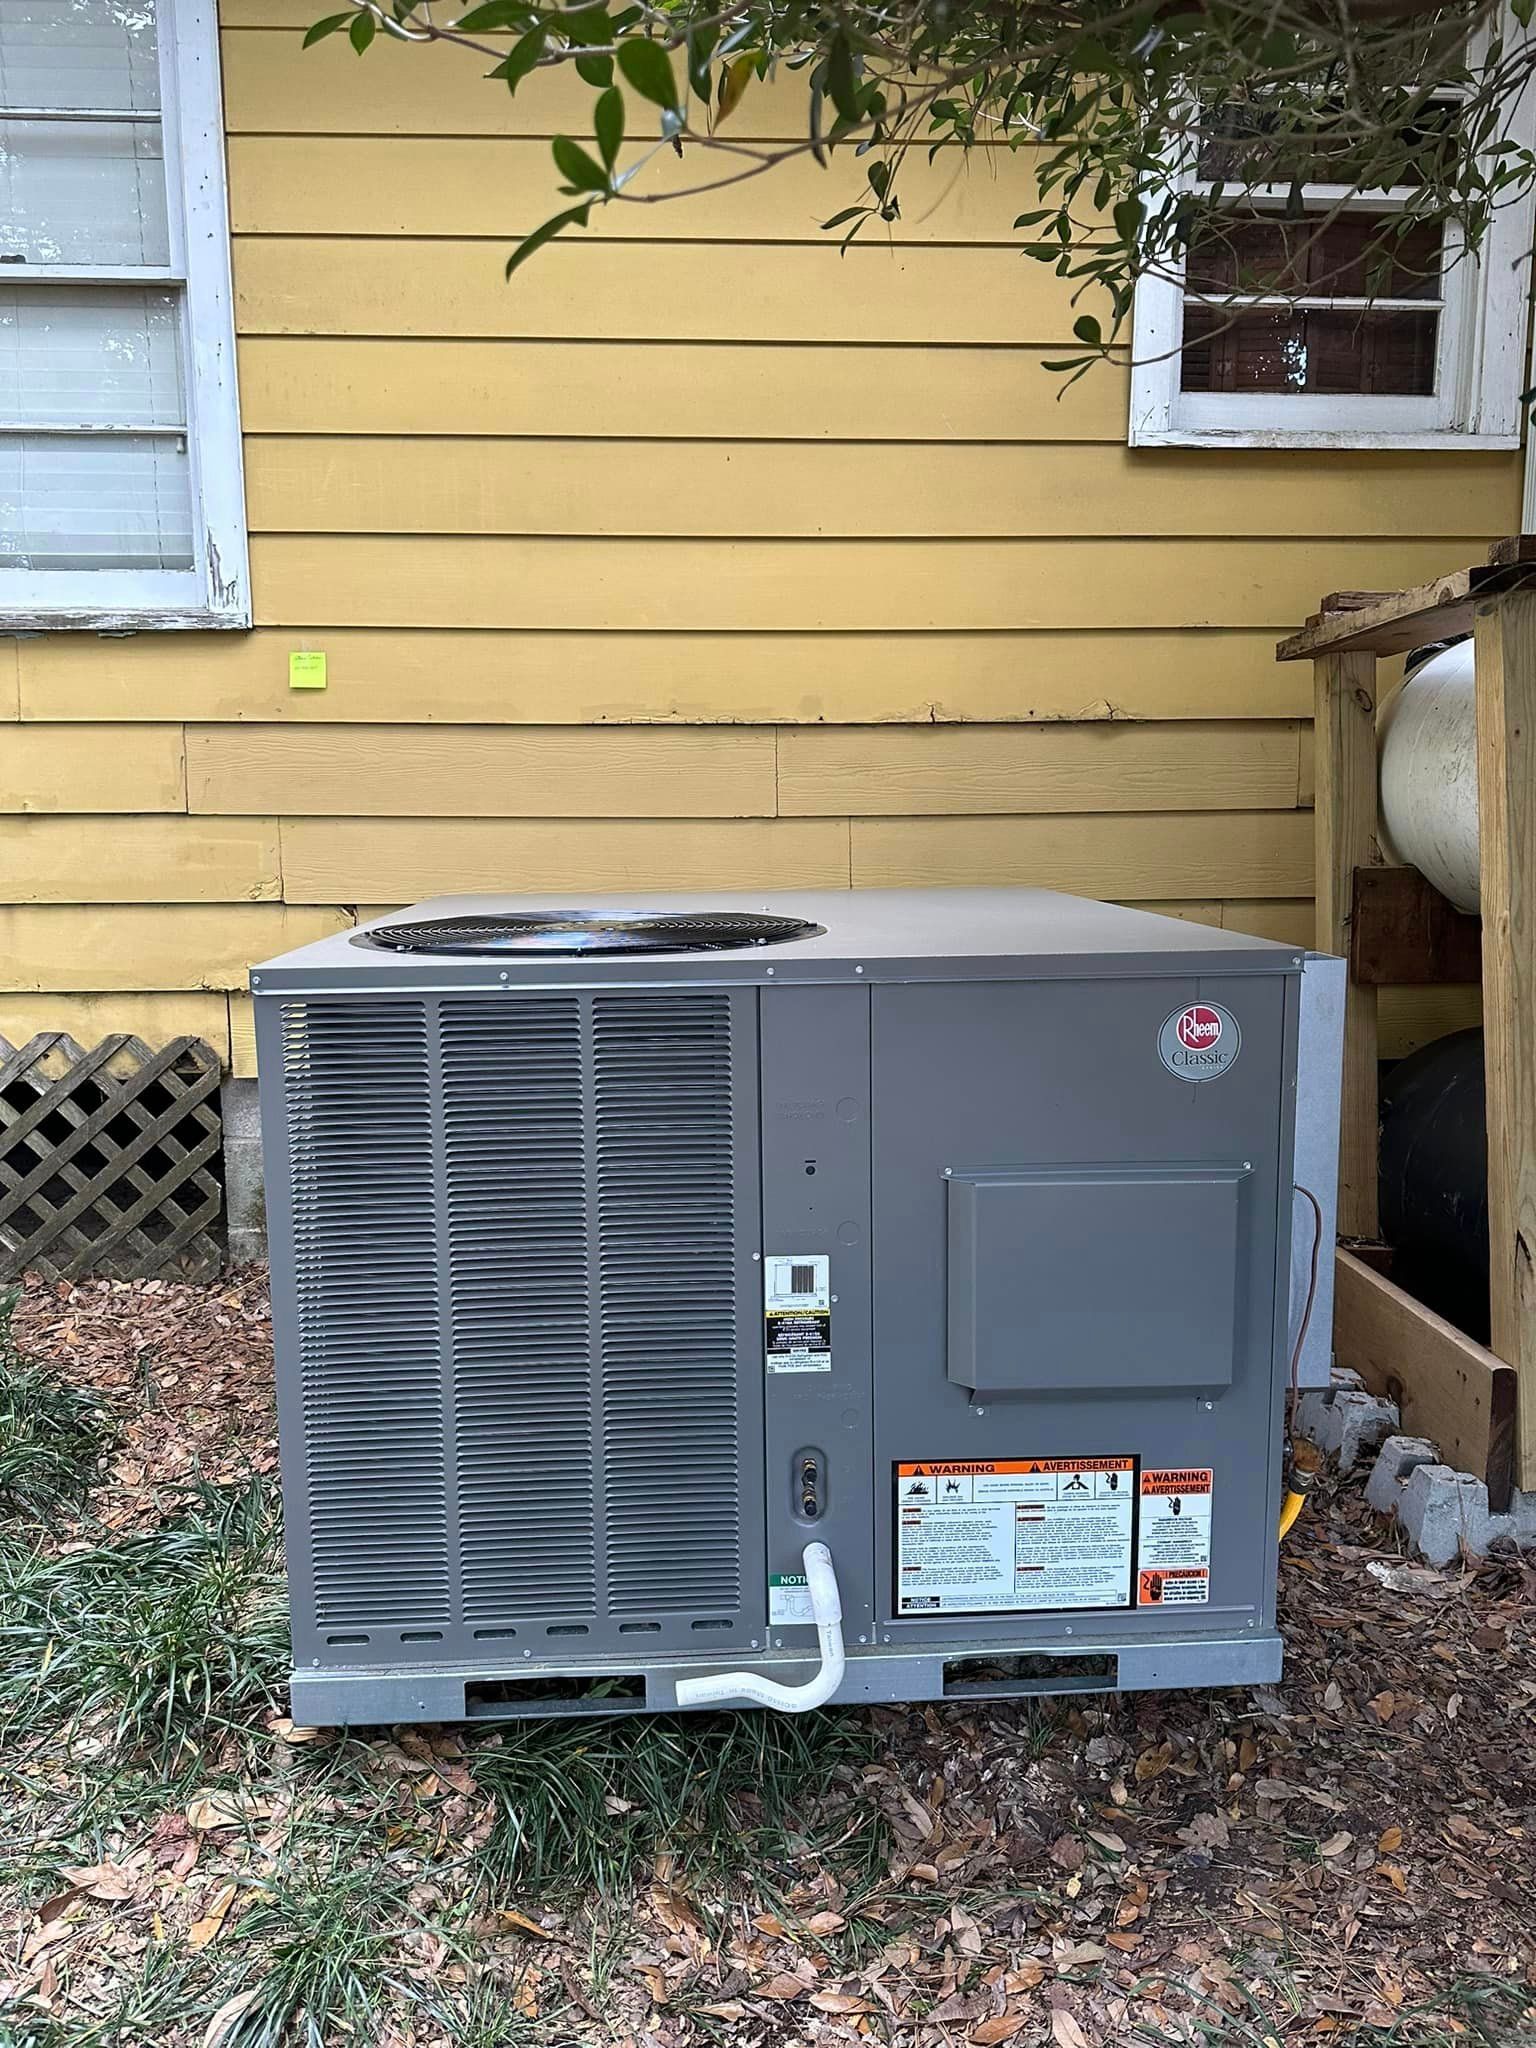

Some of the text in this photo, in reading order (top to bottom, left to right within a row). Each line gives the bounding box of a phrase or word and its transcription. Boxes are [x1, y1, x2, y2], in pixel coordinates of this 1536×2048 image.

[1183, 1008, 1219, 1042] Rheem
[1171, 1050, 1229, 1067] Classic
[929, 1464, 995, 1474] WARNING
[1043, 1460, 1128, 1471] AVERTISSEMENT
[1151, 1471, 1208, 1483] WARNING
[1151, 1484, 1211, 1495] AVERTISSEMENT
[780, 1575, 808, 1585] NOTI
